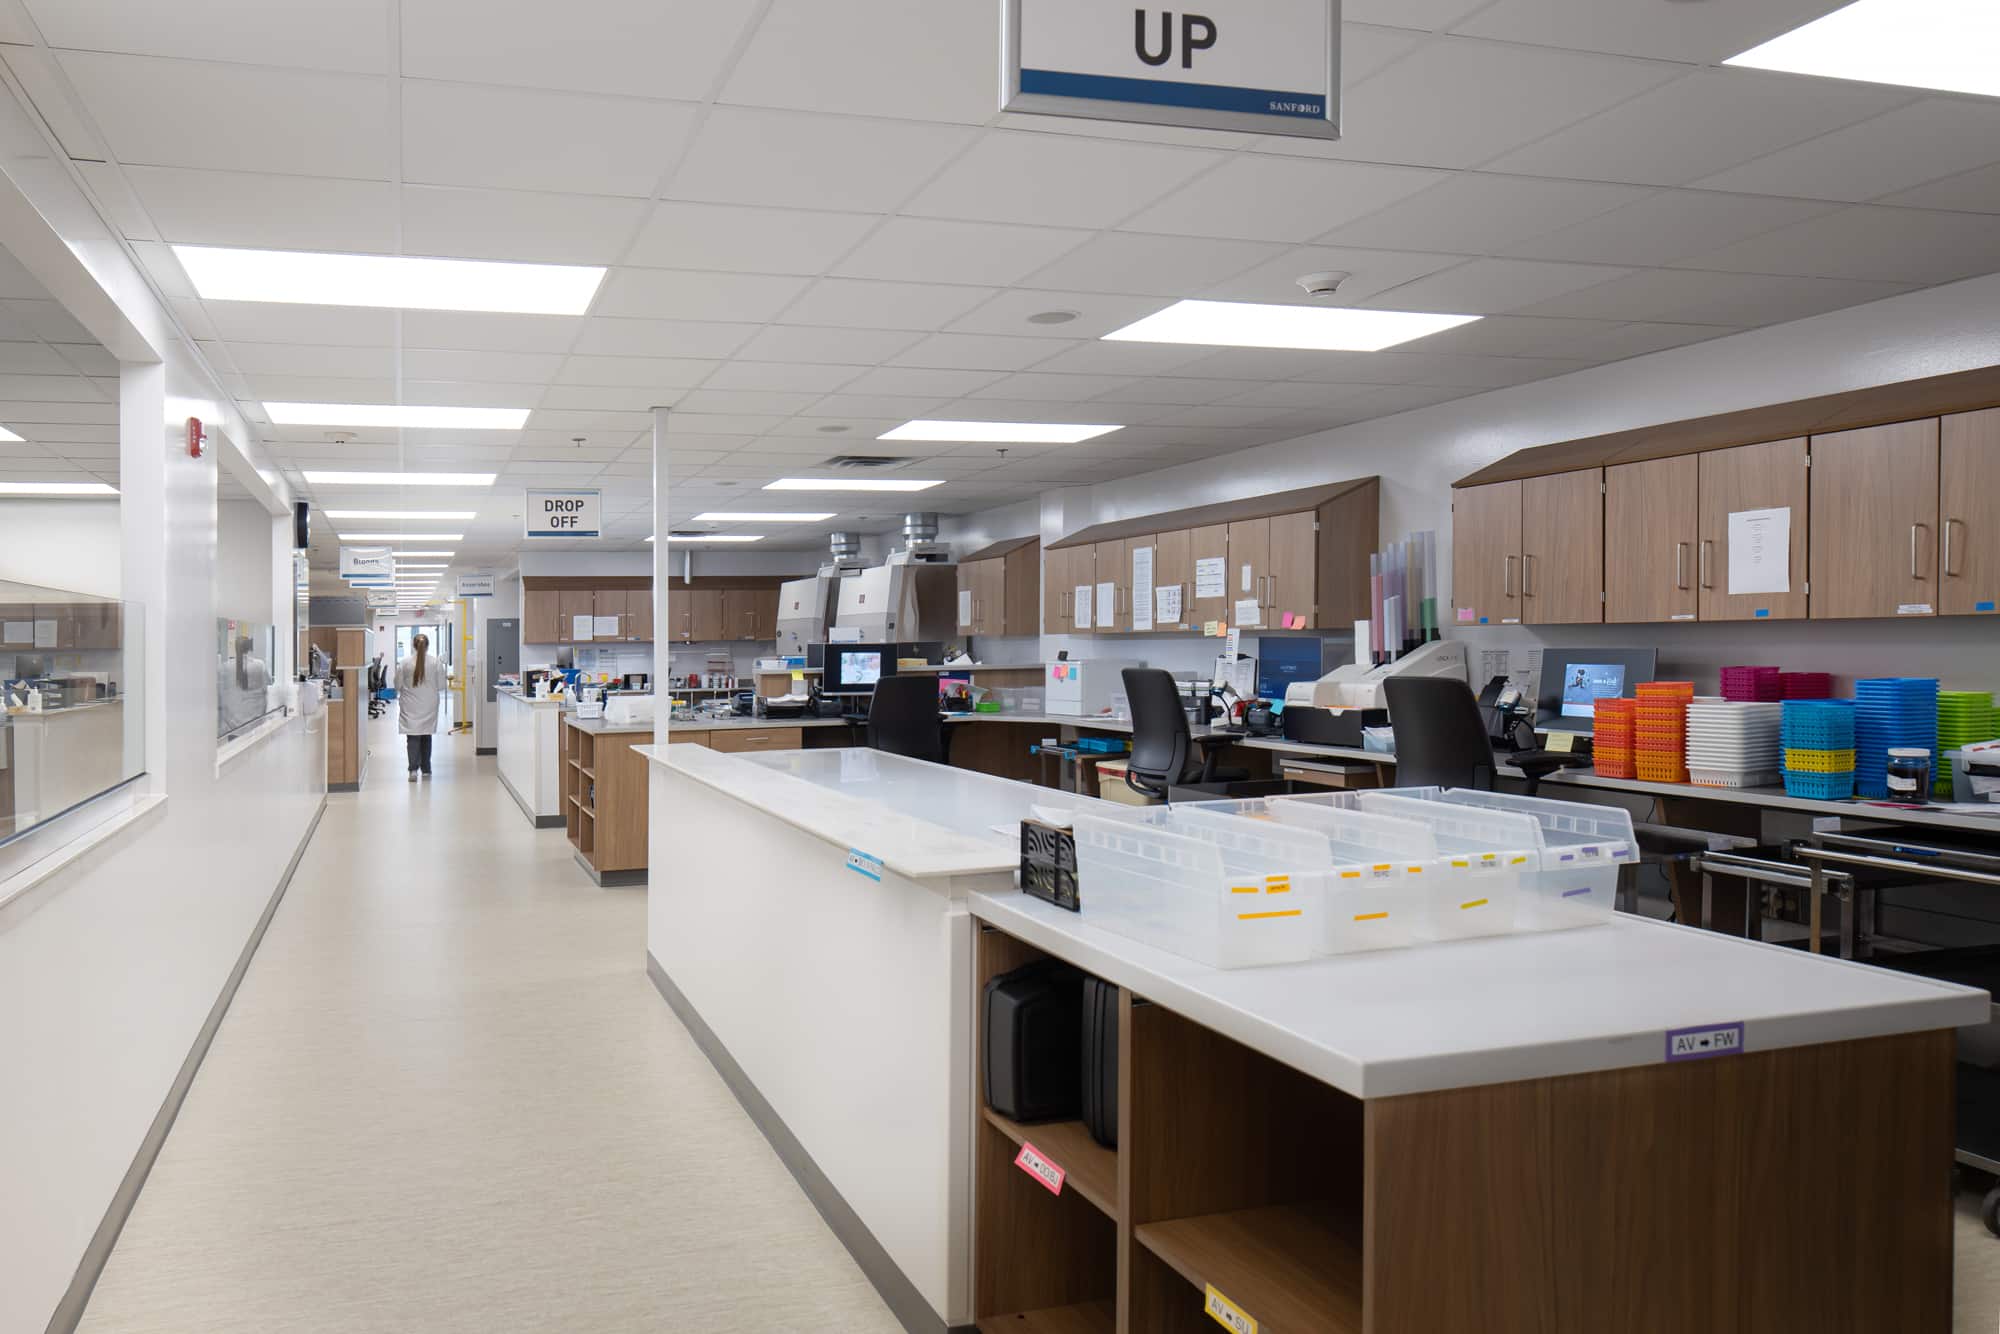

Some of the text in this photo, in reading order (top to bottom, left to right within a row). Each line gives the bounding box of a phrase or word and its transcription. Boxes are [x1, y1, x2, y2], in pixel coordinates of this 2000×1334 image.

[1134, 9, 1217, 69] UP
[1269, 101, 1320, 114] SANFORD
[544, 499, 584, 512] DROP
[550, 515, 579, 528] OFF
[1676, 1031, 1736, 1051] AV FW
[1022, 1151, 1034, 1164] AV
[1211, 1297, 1224, 1314] AV
